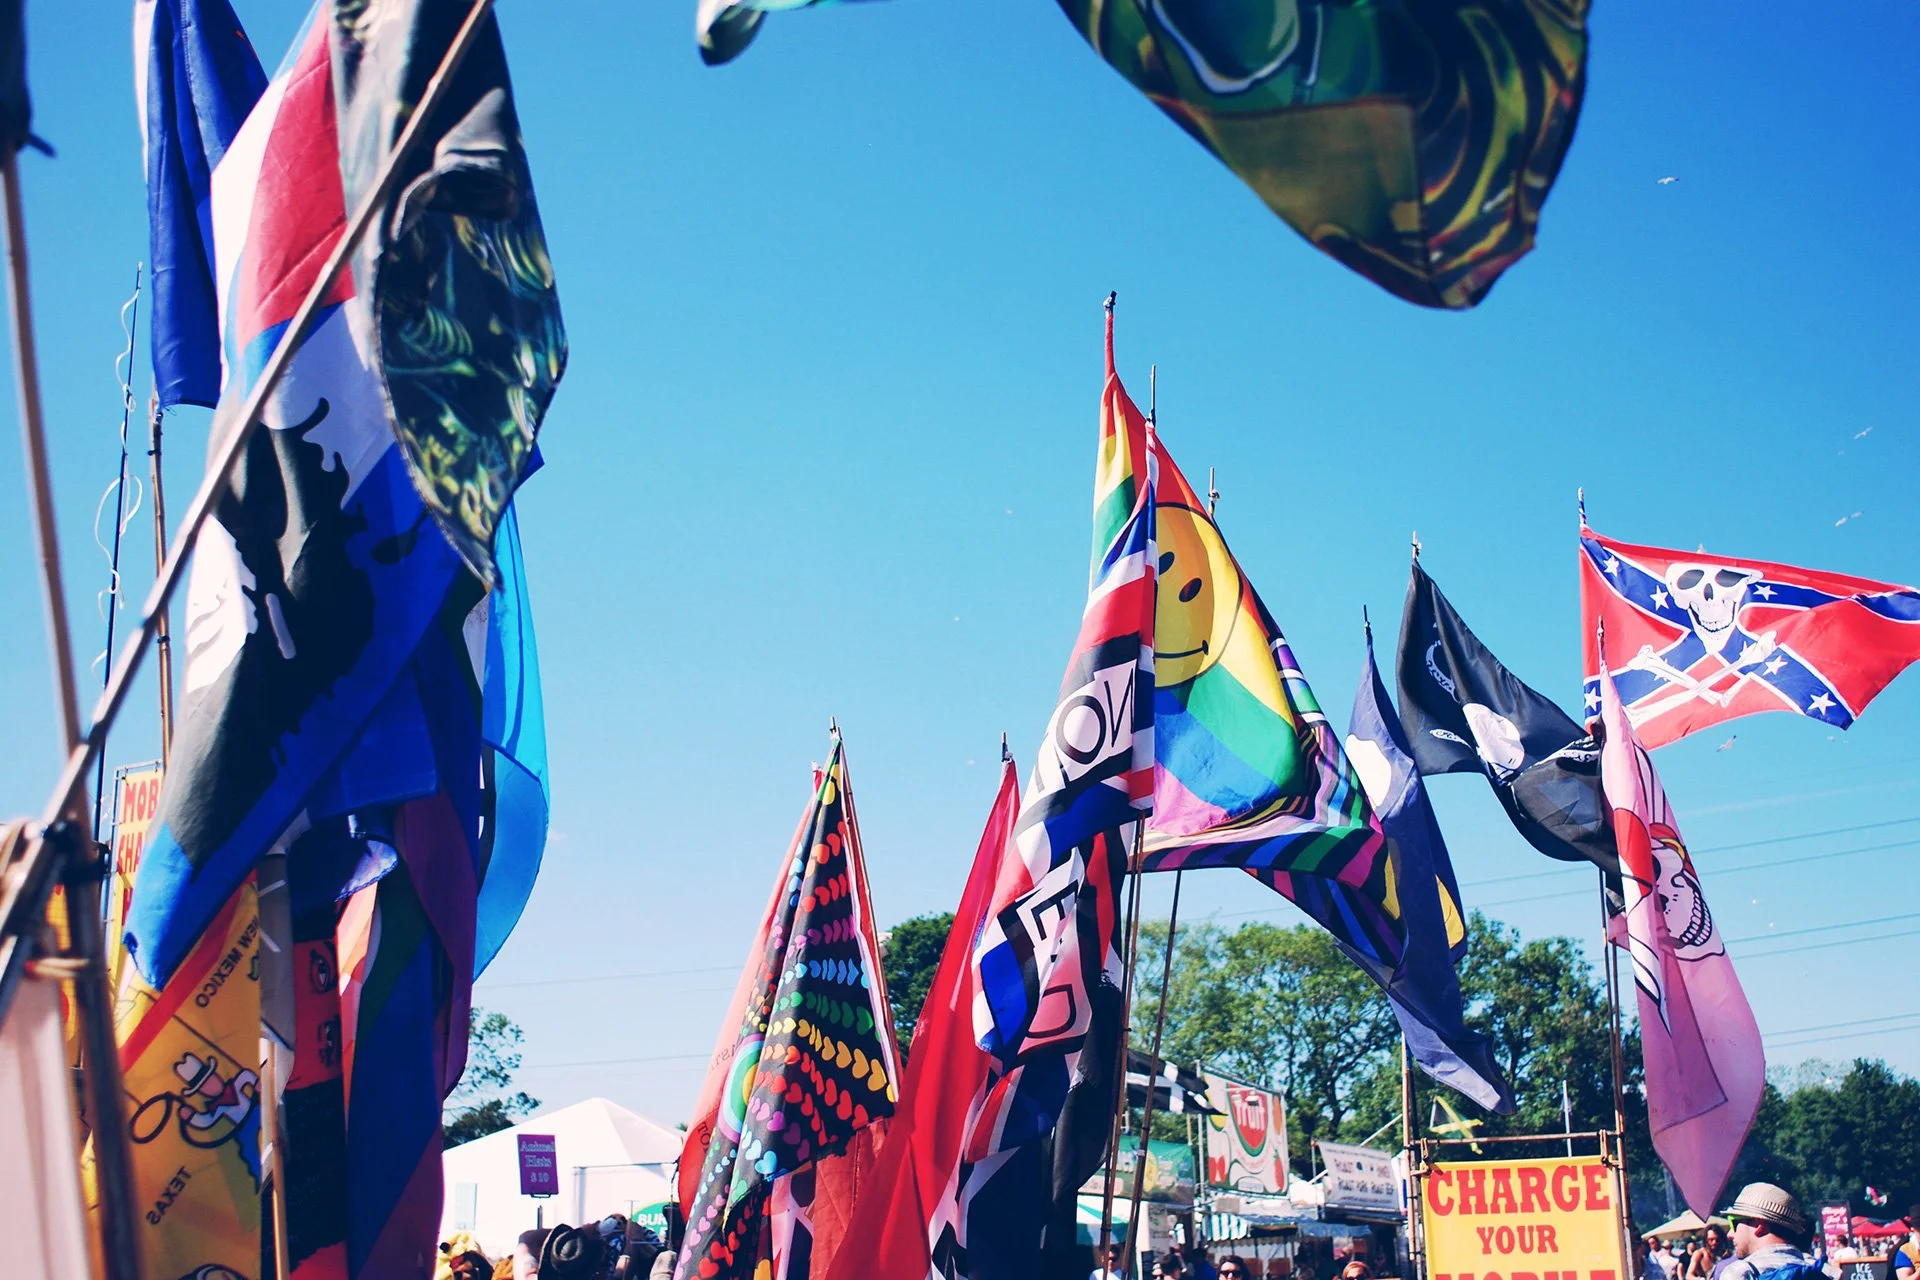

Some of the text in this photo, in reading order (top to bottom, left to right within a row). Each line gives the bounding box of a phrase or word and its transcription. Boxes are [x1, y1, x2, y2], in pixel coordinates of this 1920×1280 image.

[122, 778, 159, 824] MOB
[117, 831, 143, 876] CHA
[1428, 1164, 1611, 1216] CHARGE
[1476, 1224, 1559, 1255] YOUR
[1855, 1263, 1873, 1273] ICE
